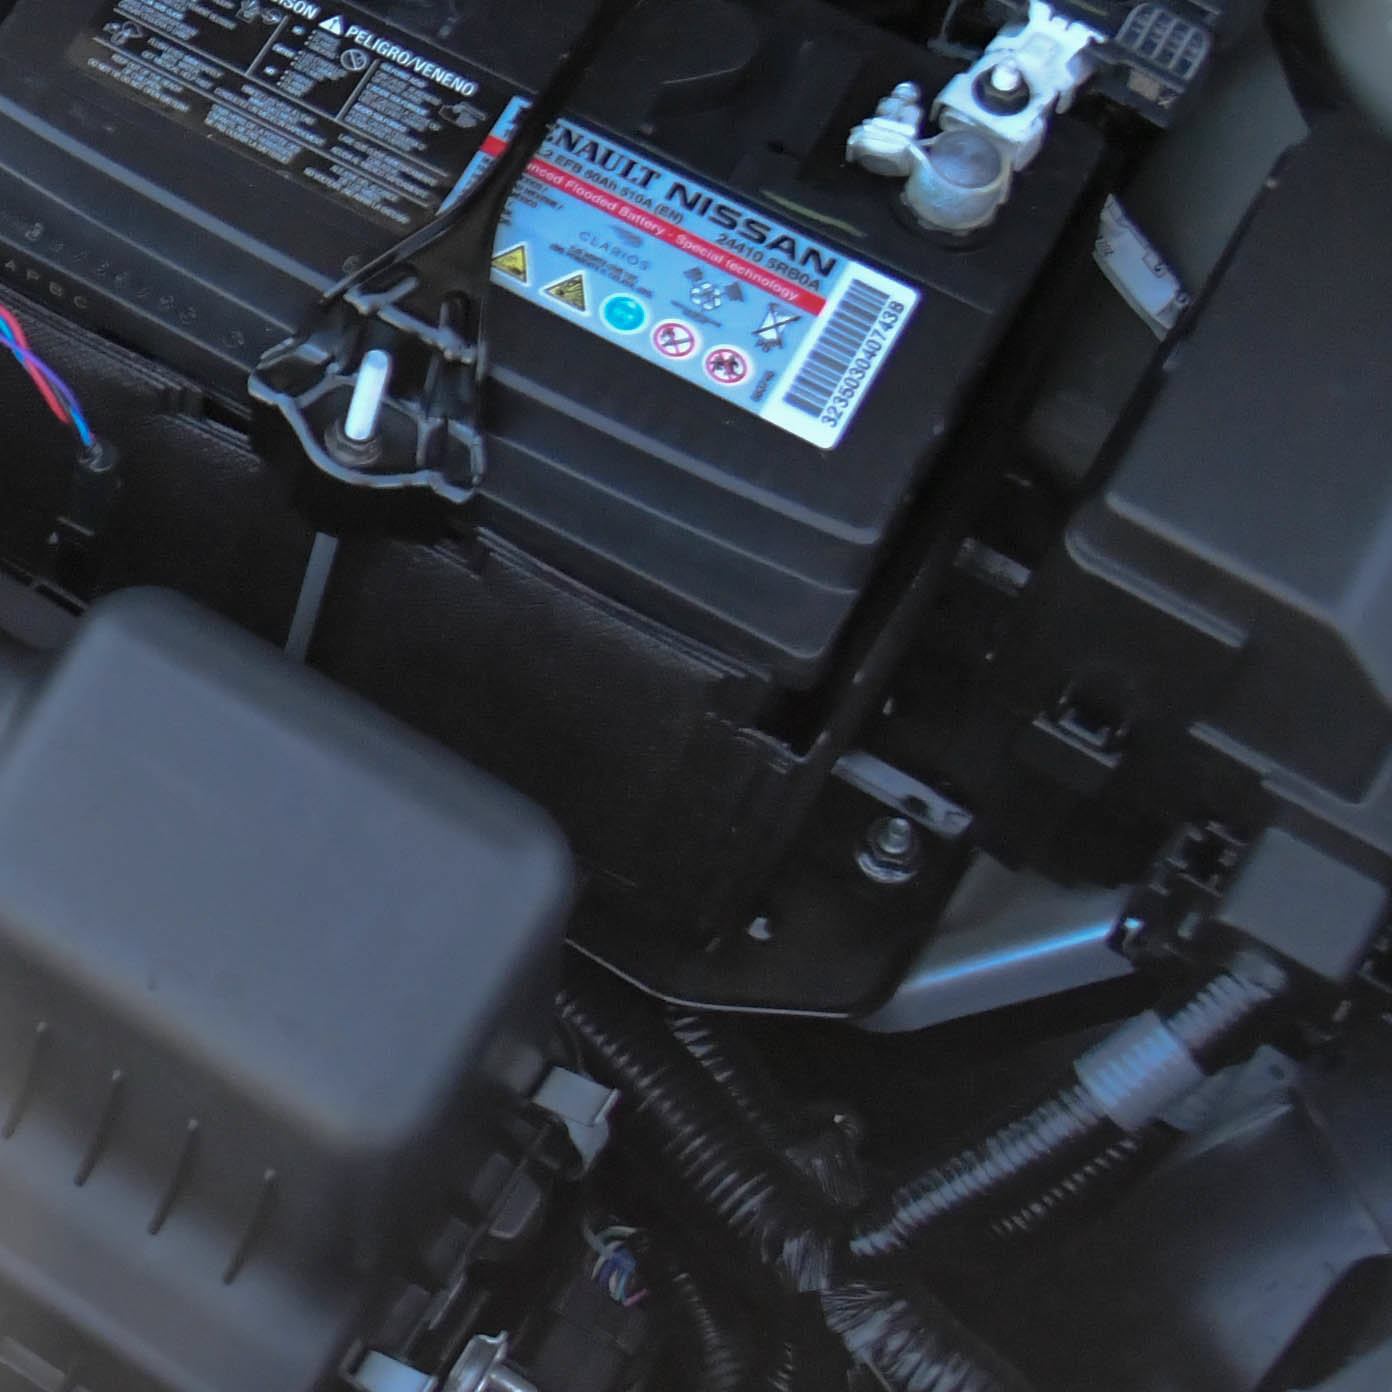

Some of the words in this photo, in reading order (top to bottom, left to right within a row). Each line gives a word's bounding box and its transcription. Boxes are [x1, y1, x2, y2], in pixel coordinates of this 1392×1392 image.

[344, 24, 480, 97] PELIGRO/VENENO
[565, 174, 617, 212] Flooded
[618, 206, 666, 237] Battery
[674, 232, 725, 264] Special
[725, 255, 801, 303] technology
[665, 181, 839, 278] NISSAN
[715, 232, 764, 264] 24410
